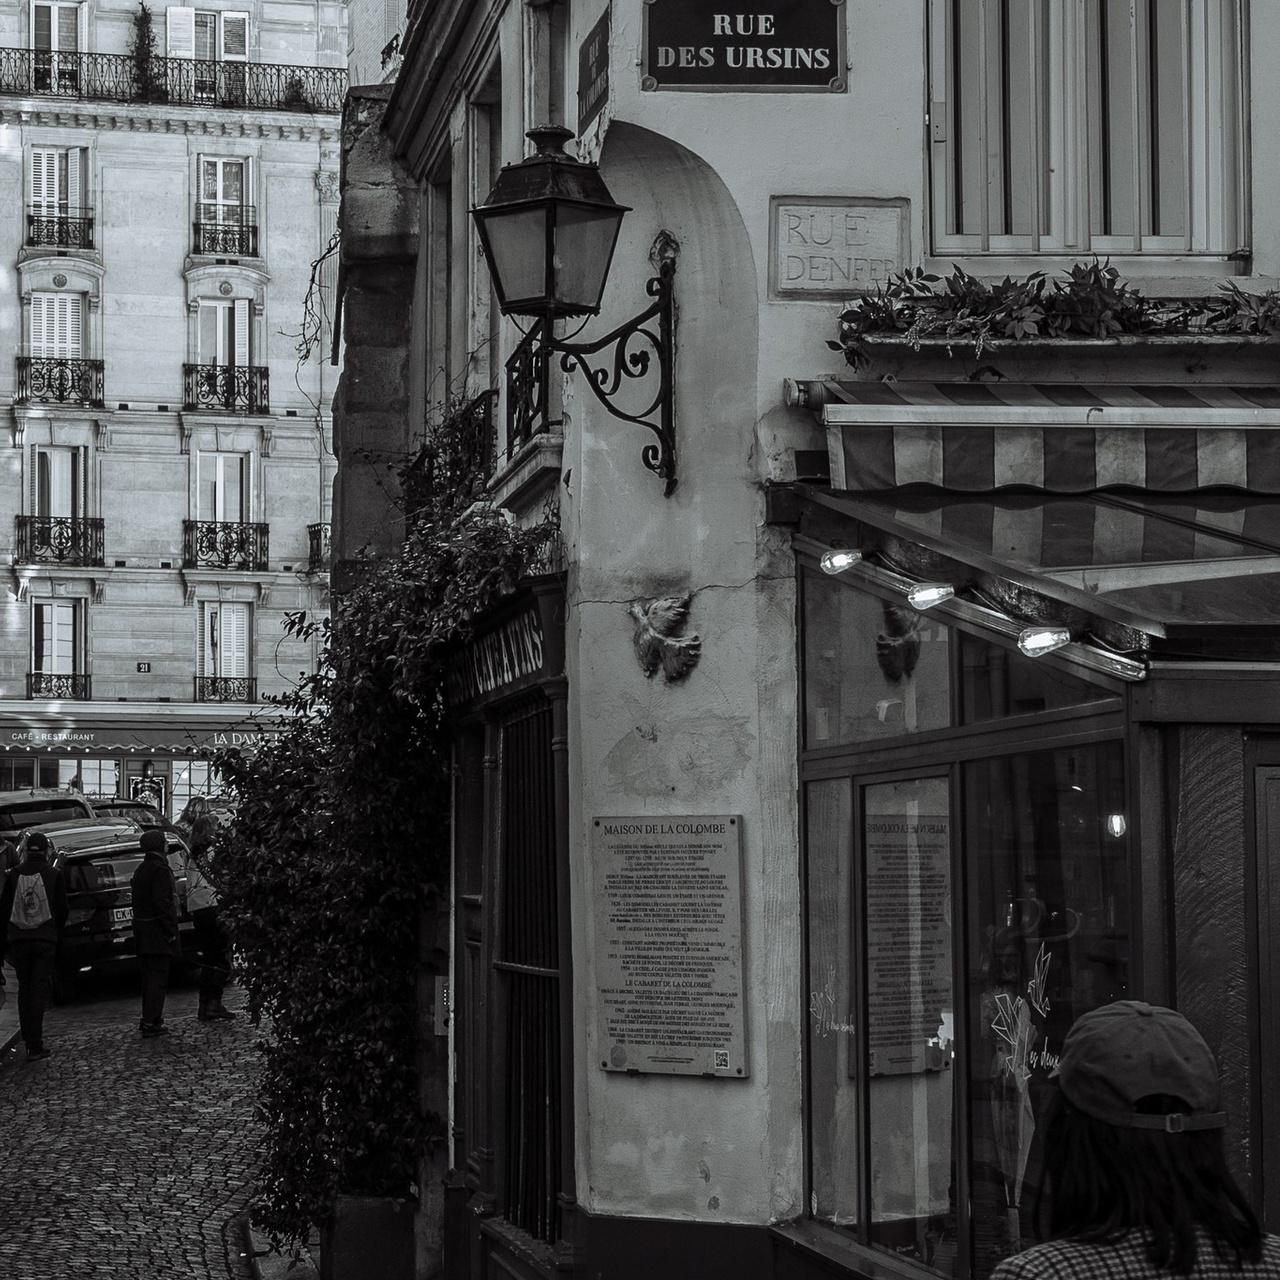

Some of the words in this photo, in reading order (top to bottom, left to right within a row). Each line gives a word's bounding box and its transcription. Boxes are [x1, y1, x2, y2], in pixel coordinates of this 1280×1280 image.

[713, 14, 775, 36] RUE
[657, 46, 715, 68] DES
[726, 46, 830, 70] URSINS
[785, 213, 869, 247] RUE
[786, 255, 896, 282] DENFER
[507, 609, 543, 678] VINS
[11, 732, 33, 740] CAFÉ
[41, 733, 95, 741] RESTAURANT
[214, 733, 228, 744] LA
[603, 824, 643, 835] MAISON
[644, 824, 658, 834] DE
[660, 823, 674, 834] LA
[675, 823, 726, 834] COLOMBE
[633, 979, 662, 987] CABARET
